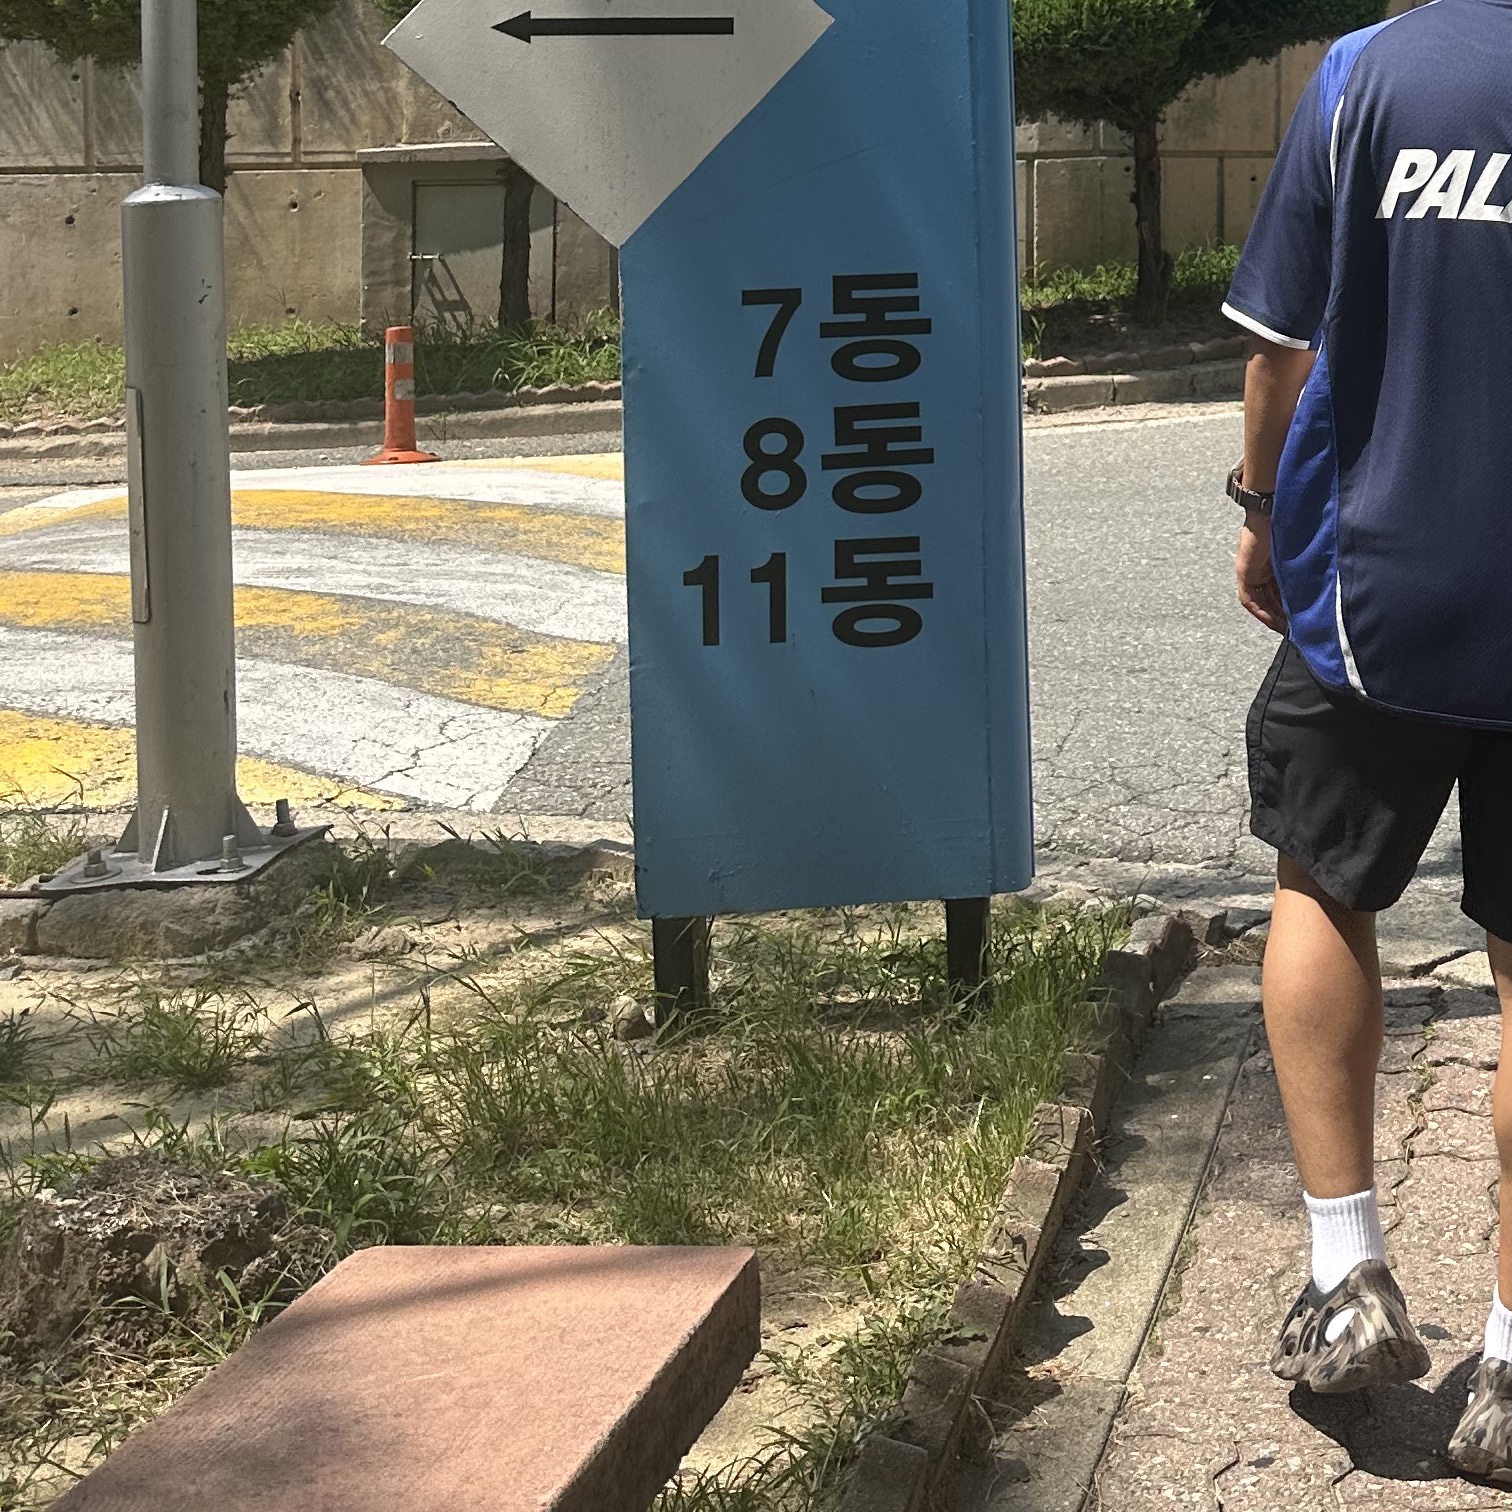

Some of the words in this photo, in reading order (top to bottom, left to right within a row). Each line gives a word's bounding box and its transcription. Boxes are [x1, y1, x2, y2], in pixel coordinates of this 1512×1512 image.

[741, 271, 933, 384] 7동
[740, 401, 935, 515] 8동
[682, 535, 935, 649] 11동
